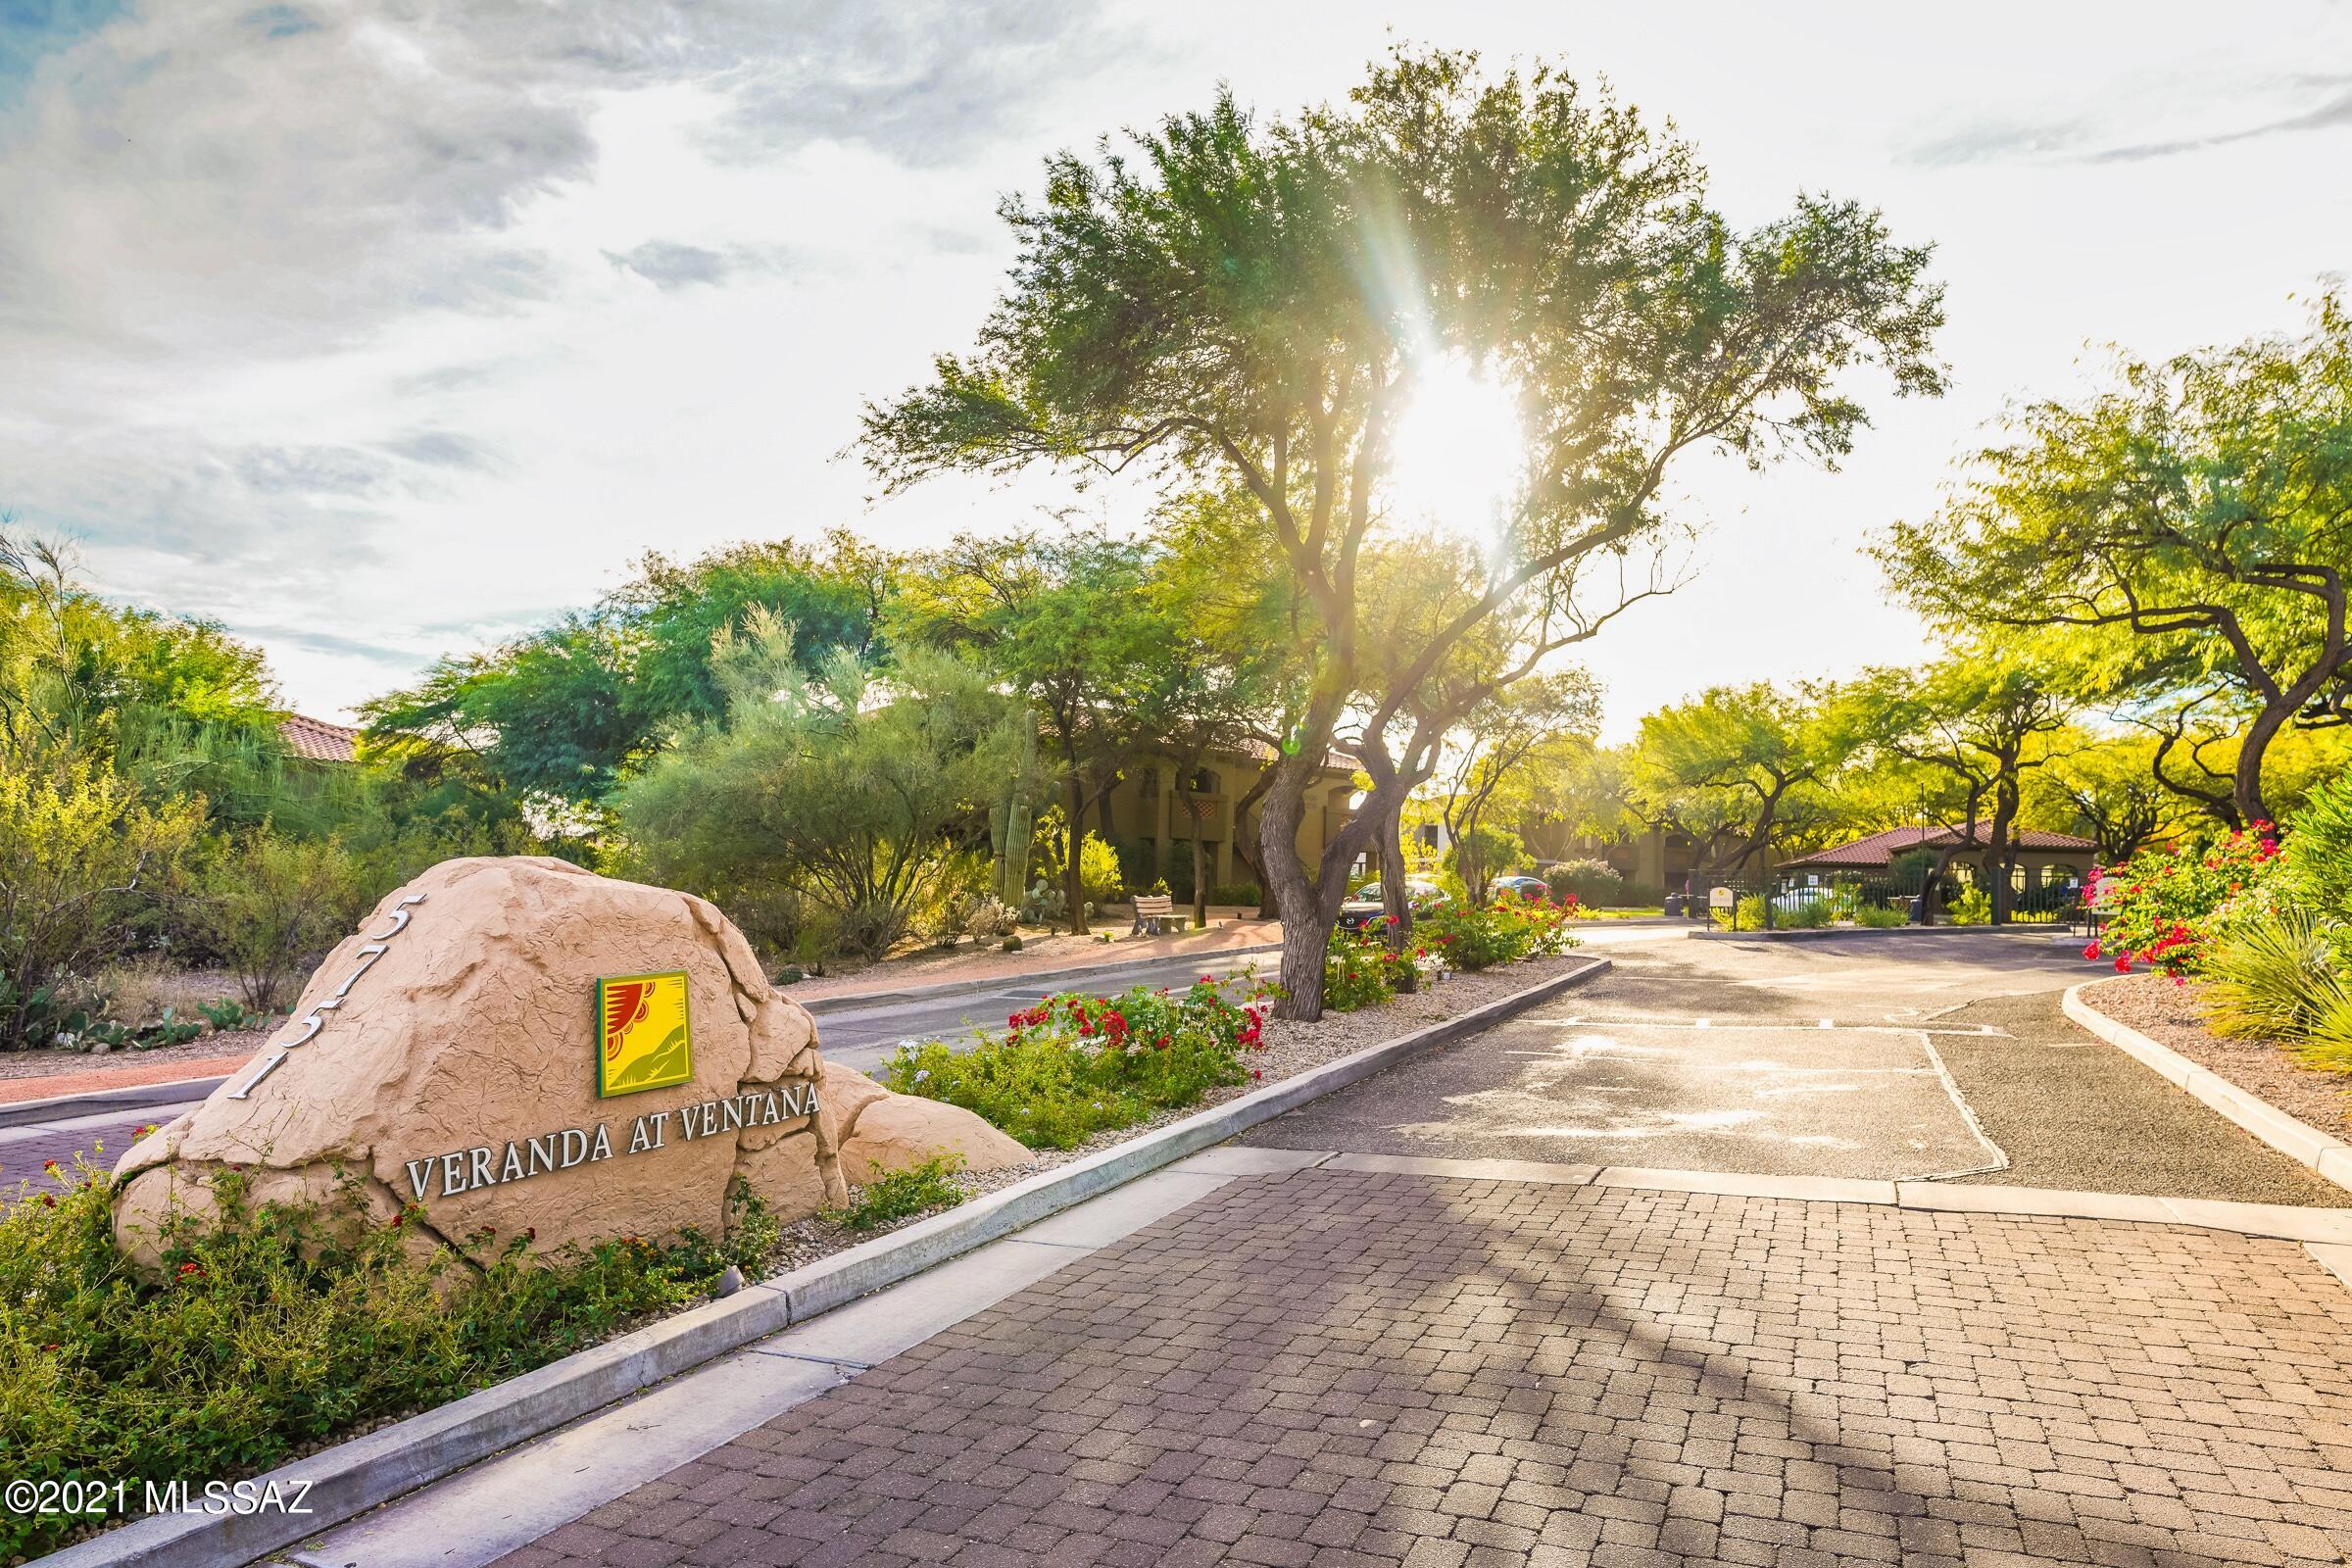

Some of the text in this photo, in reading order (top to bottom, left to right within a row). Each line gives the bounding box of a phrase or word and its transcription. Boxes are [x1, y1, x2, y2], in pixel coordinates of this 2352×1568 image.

[405, 1082, 822, 1201] VERANDA AT VENTANA
